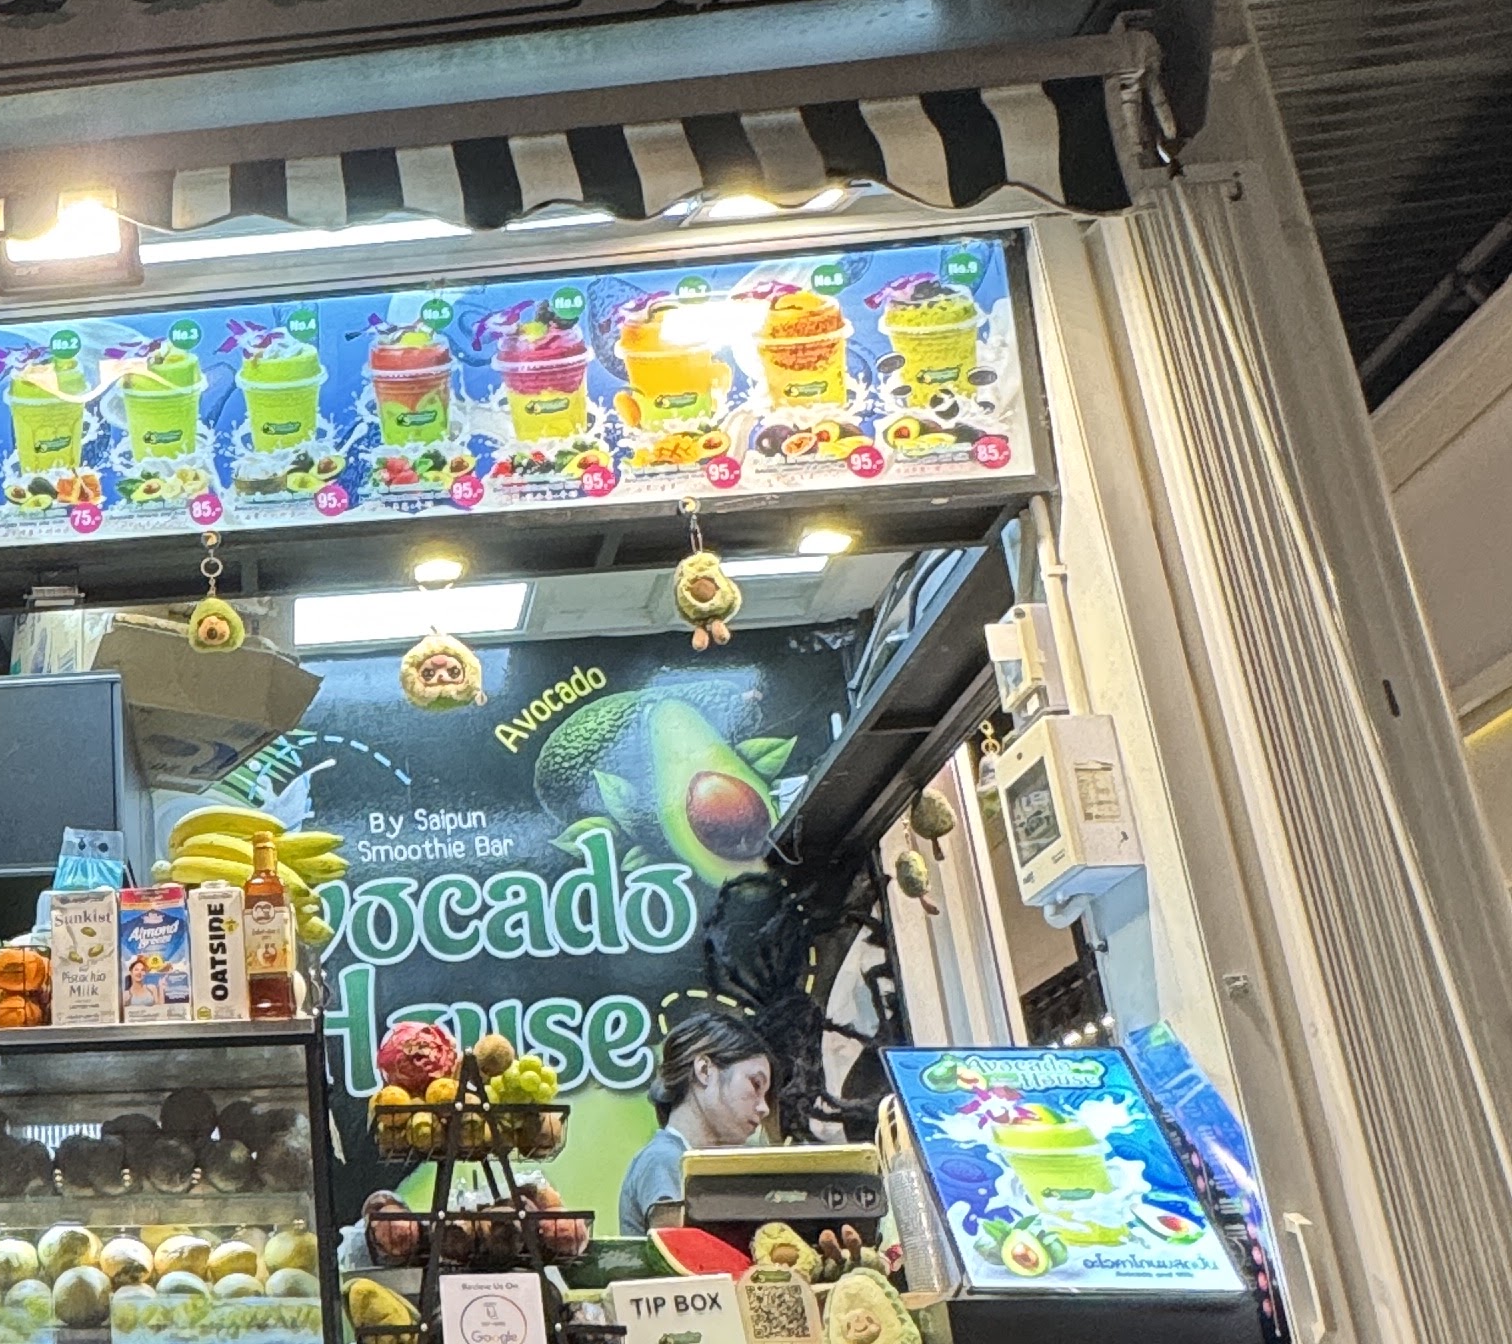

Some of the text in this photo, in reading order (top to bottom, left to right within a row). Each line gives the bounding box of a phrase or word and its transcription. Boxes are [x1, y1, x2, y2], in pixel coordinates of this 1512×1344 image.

[494, 665, 607, 754] Avocado
[369, 808, 487, 839] By Saipun
[357, 835, 514, 862] Smoothie Bar
[314, 828, 697, 965] vocado
[55, 909, 113, 928] Sunkist
[207, 902, 230, 1002] OATSIDE
[69, 985, 99, 998] Milk
[967, 1054, 1071, 1074] Avocado
[1020, 1072, 1098, 1090] House
[630, 1291, 722, 1320] TIP BOX
